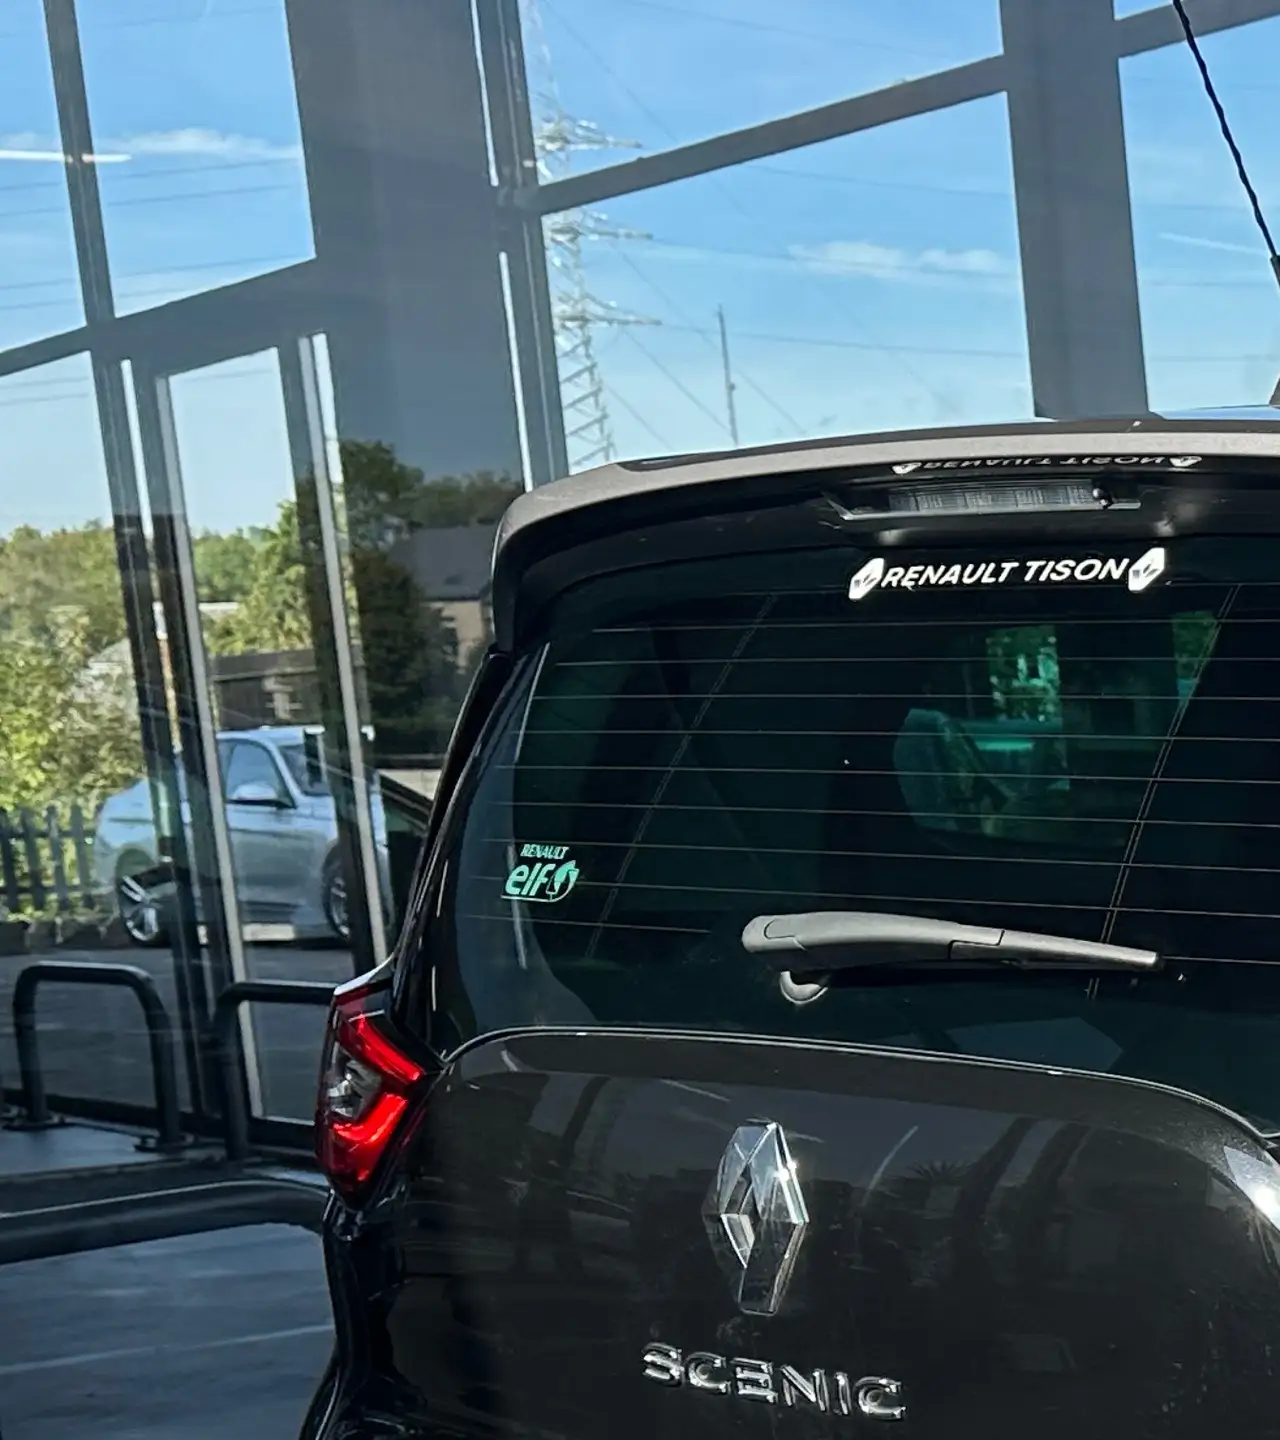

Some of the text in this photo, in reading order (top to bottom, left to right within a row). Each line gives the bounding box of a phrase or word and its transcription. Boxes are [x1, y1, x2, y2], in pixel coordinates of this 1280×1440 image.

[880, 557, 1131, 589] RENAULT TISON
[519, 843, 570, 860] RENAULT
[504, 862, 557, 897] elf
[641, 1341, 907, 1421] SCENIC
